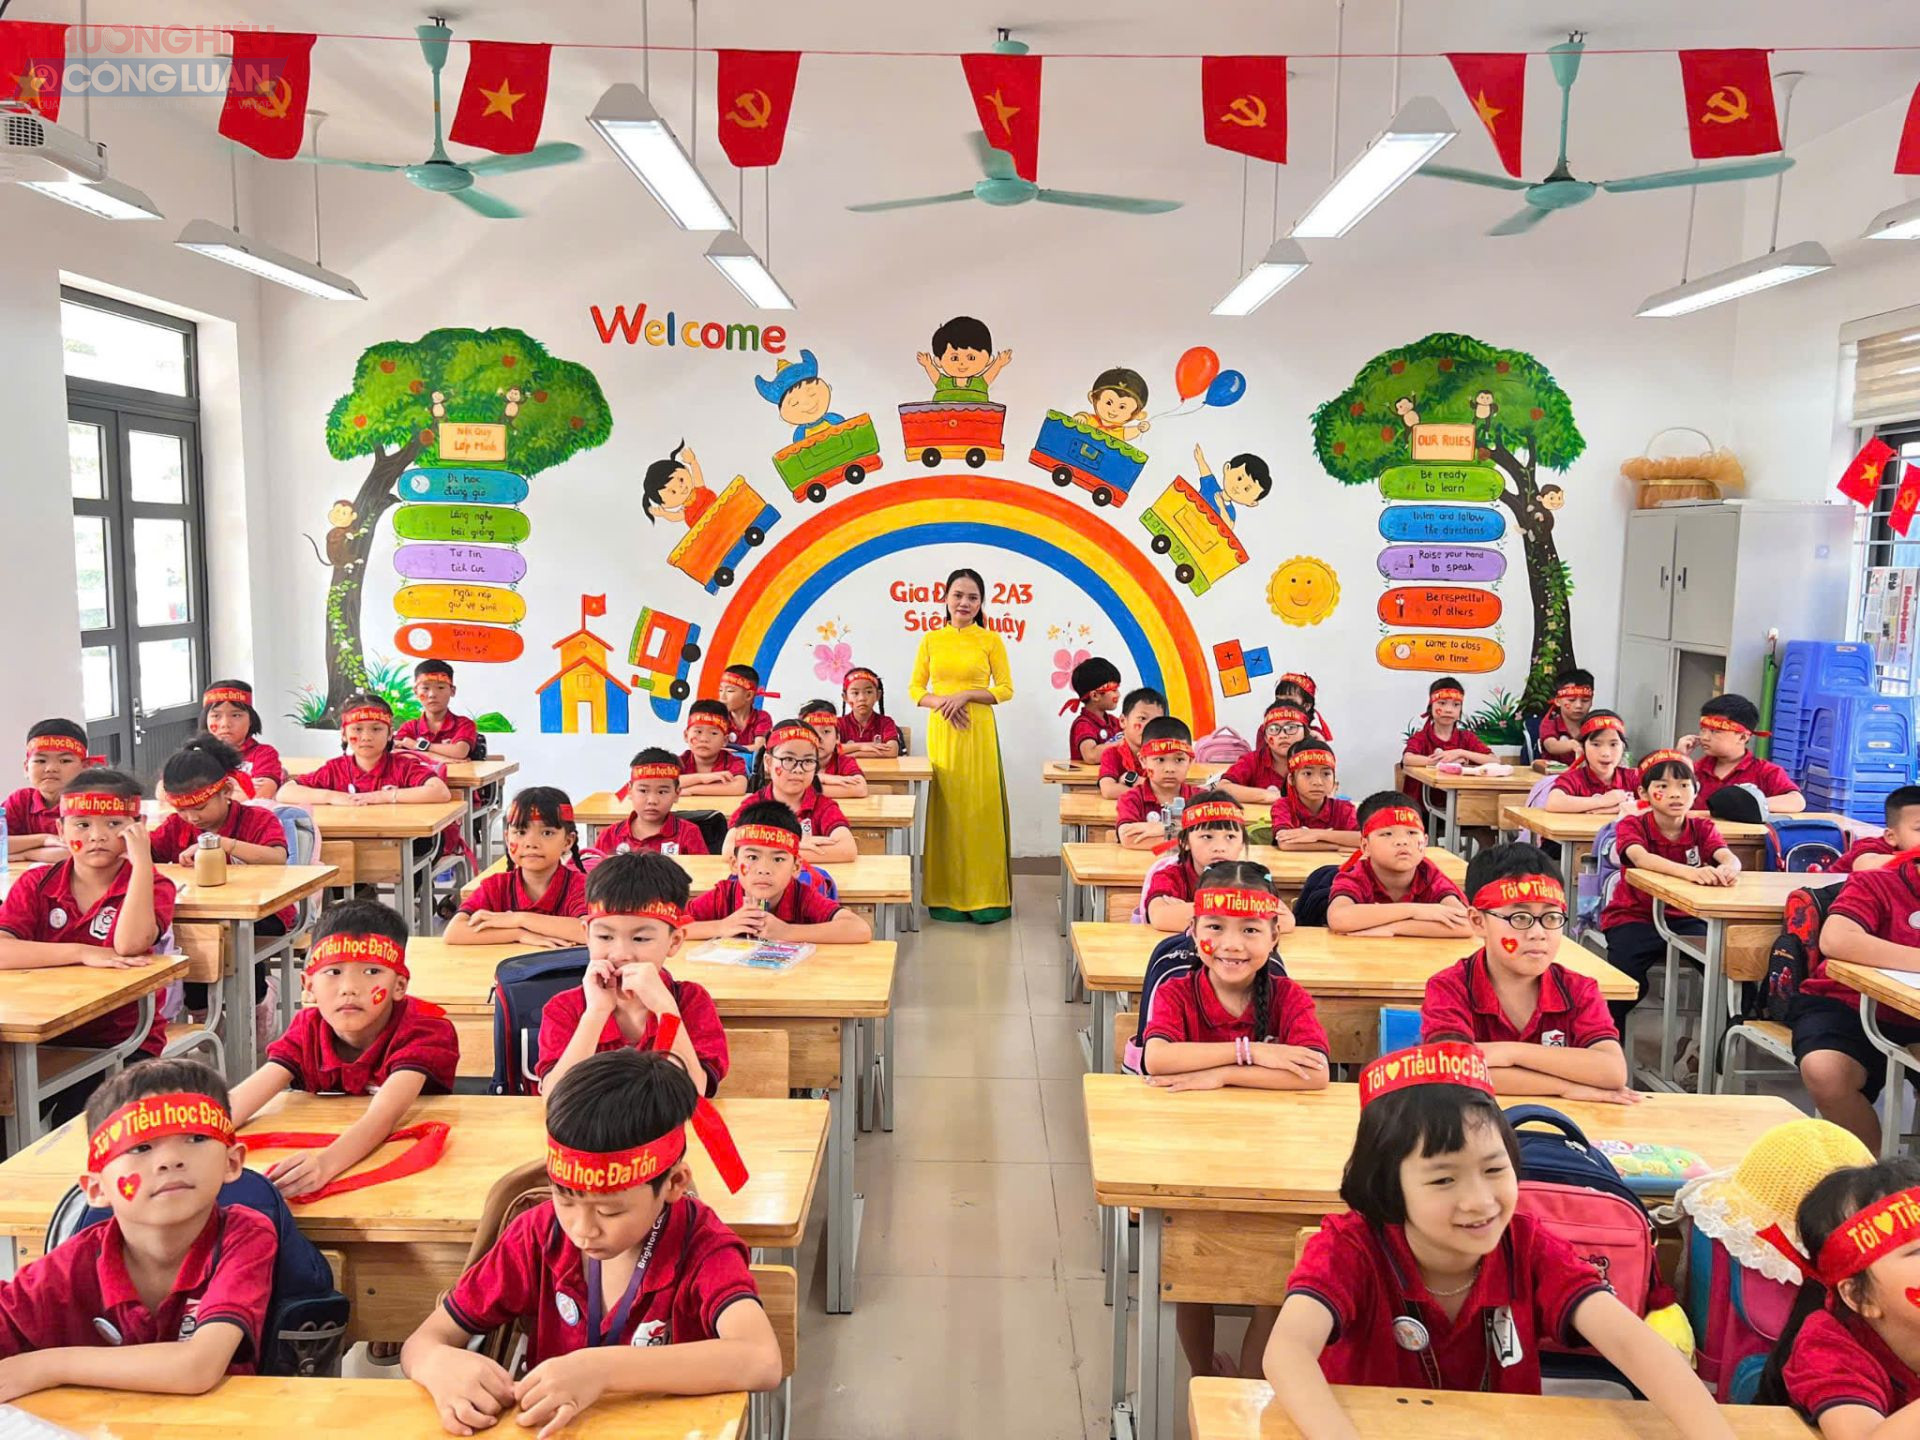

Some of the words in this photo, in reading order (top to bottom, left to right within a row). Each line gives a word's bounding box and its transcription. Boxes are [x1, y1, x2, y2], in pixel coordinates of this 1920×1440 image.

[590, 303, 787, 354] Welcome
[1418, 434, 1438, 446] OUR
[1442, 434, 1471, 446] RULES
[1420, 469, 1433, 479] Be
[1438, 470, 1467, 483] ready
[1425, 483, 1435, 493] to
[1441, 483, 1465, 493] learn
[1439, 511, 1454, 521] and
[1457, 511, 1485, 521] follow
[1424, 524, 1439, 535] the
[1419, 550, 1442, 559] Raise
[1444, 550, 1463, 561] your
[1465, 550, 1484, 559] hand
[1431, 563, 1440, 573] to
[1446, 564, 1474, 575] speak
[890, 581, 929, 603] Gia
[991, 582, 1034, 605] 2A3
[1426, 592, 1438, 602] Be
[1432, 605, 1442, 616] of
[1445, 605, 1474, 617] others
[904, 609, 948, 632] Siê
[1450, 640, 1459, 649] to
[1461, 641, 1481, 650] class
[1434, 653, 1445, 662] on
[1450, 654, 1469, 663] time
[93, 797, 112, 813] học
[1394, 809, 1406, 822] Tôi
[760, 827, 776, 843] học
[1500, 882, 1518, 900] Tôi
[1225, 891, 1249, 911] Tiểu
[321, 934, 342, 958] Tiểu
[343, 937, 367, 958] học
[1367, 1064, 1385, 1095] Tôi
[1401, 1048, 1436, 1079] Tiểu
[1438, 1050, 1470, 1081] học
[123, 1102, 161, 1136] Tiểu
[164, 1102, 198, 1128] học
[573, 1160, 605, 1190] học
[1846, 1219, 1881, 1255] Tôi
[1887, 1193, 1920, 1230] Tiể
[637, 1231, 658, 1269] Brighton
